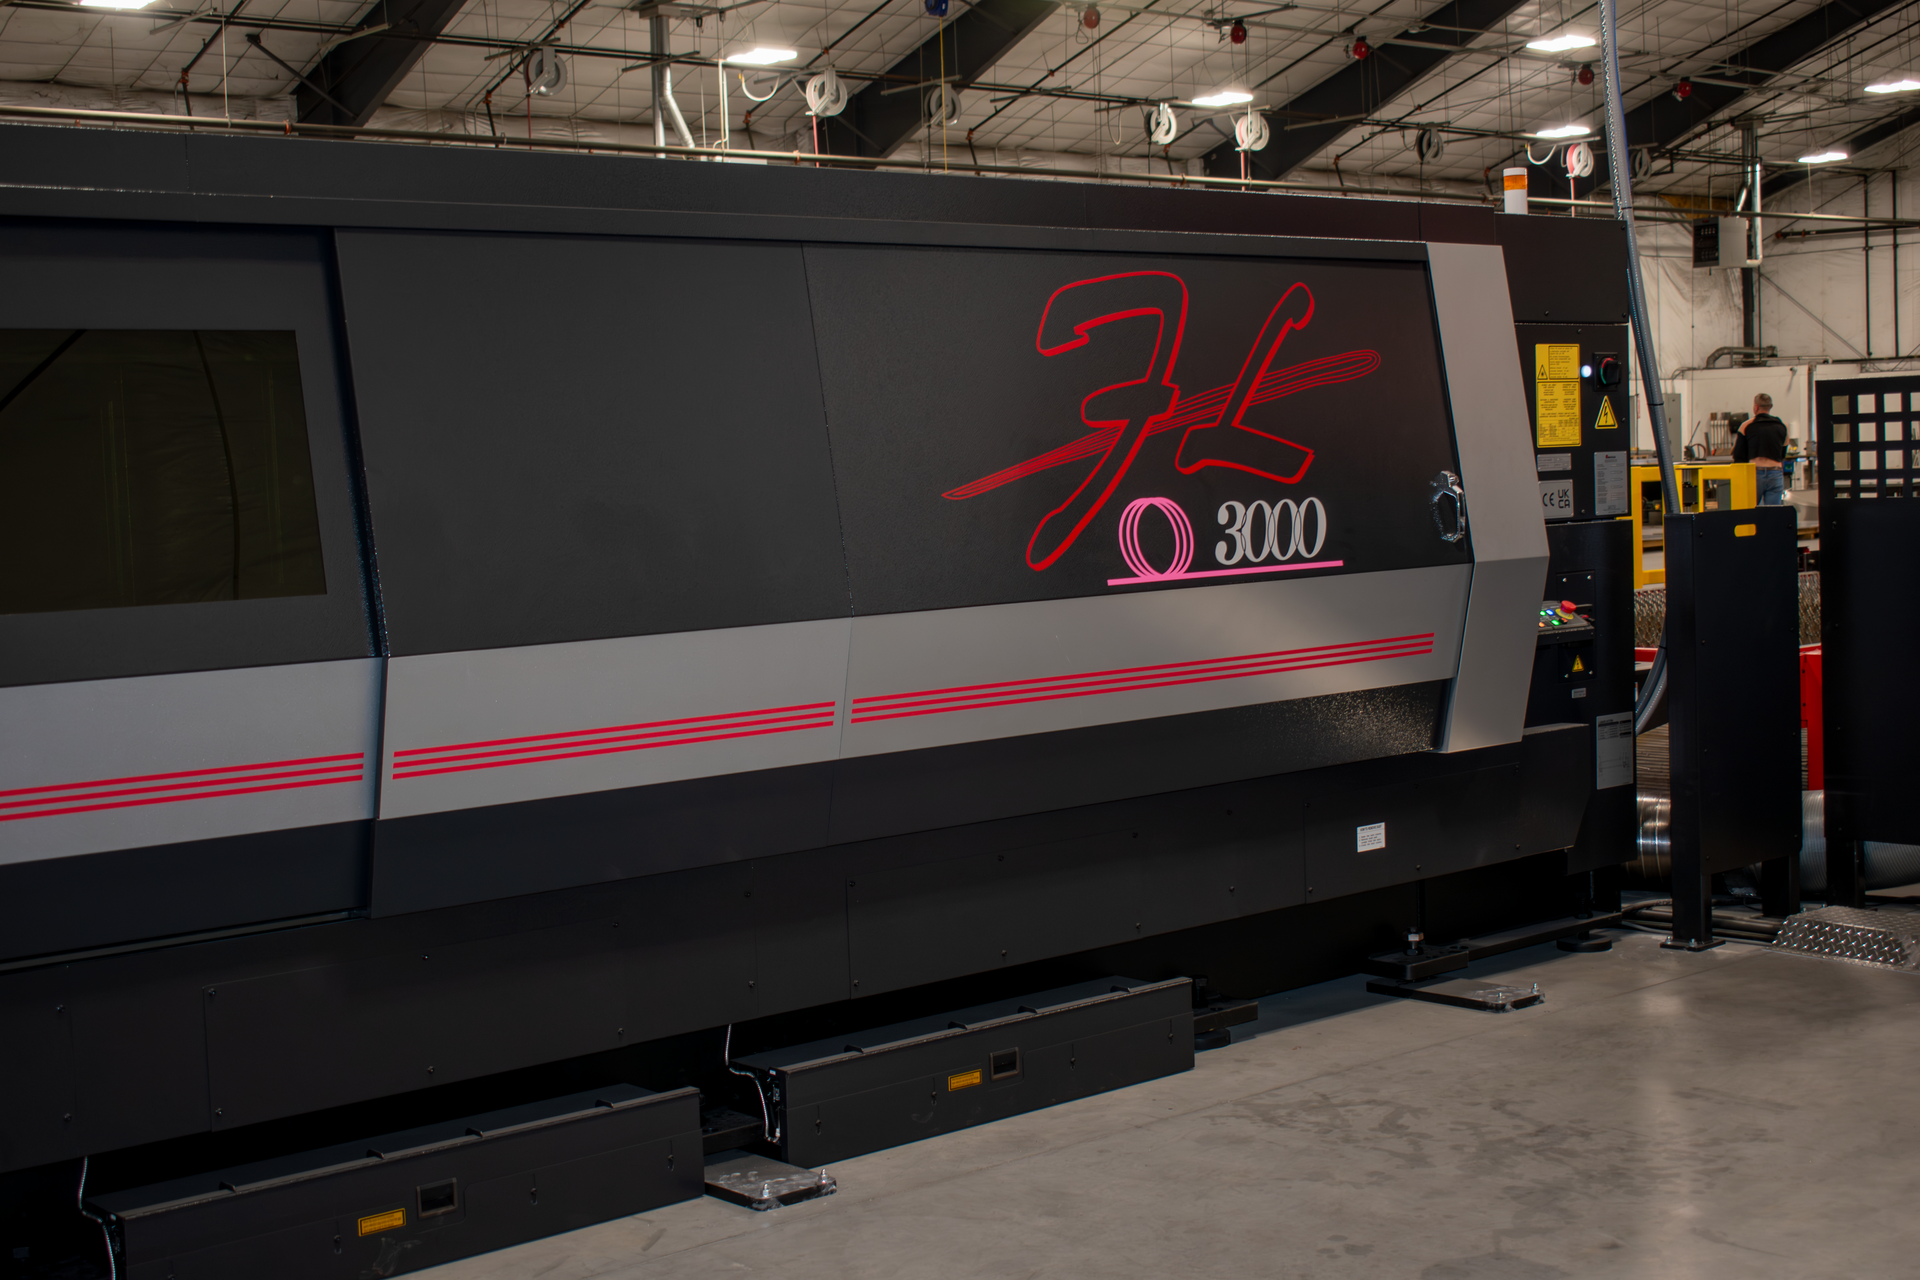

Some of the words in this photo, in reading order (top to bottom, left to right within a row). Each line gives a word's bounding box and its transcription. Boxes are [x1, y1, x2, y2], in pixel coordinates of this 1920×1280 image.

[1542, 492, 1555, 507] CE
[1557, 488, 1570, 499] UK
[1557, 499, 1571, 509] CA
[1215, 496, 1328, 566] 3000
